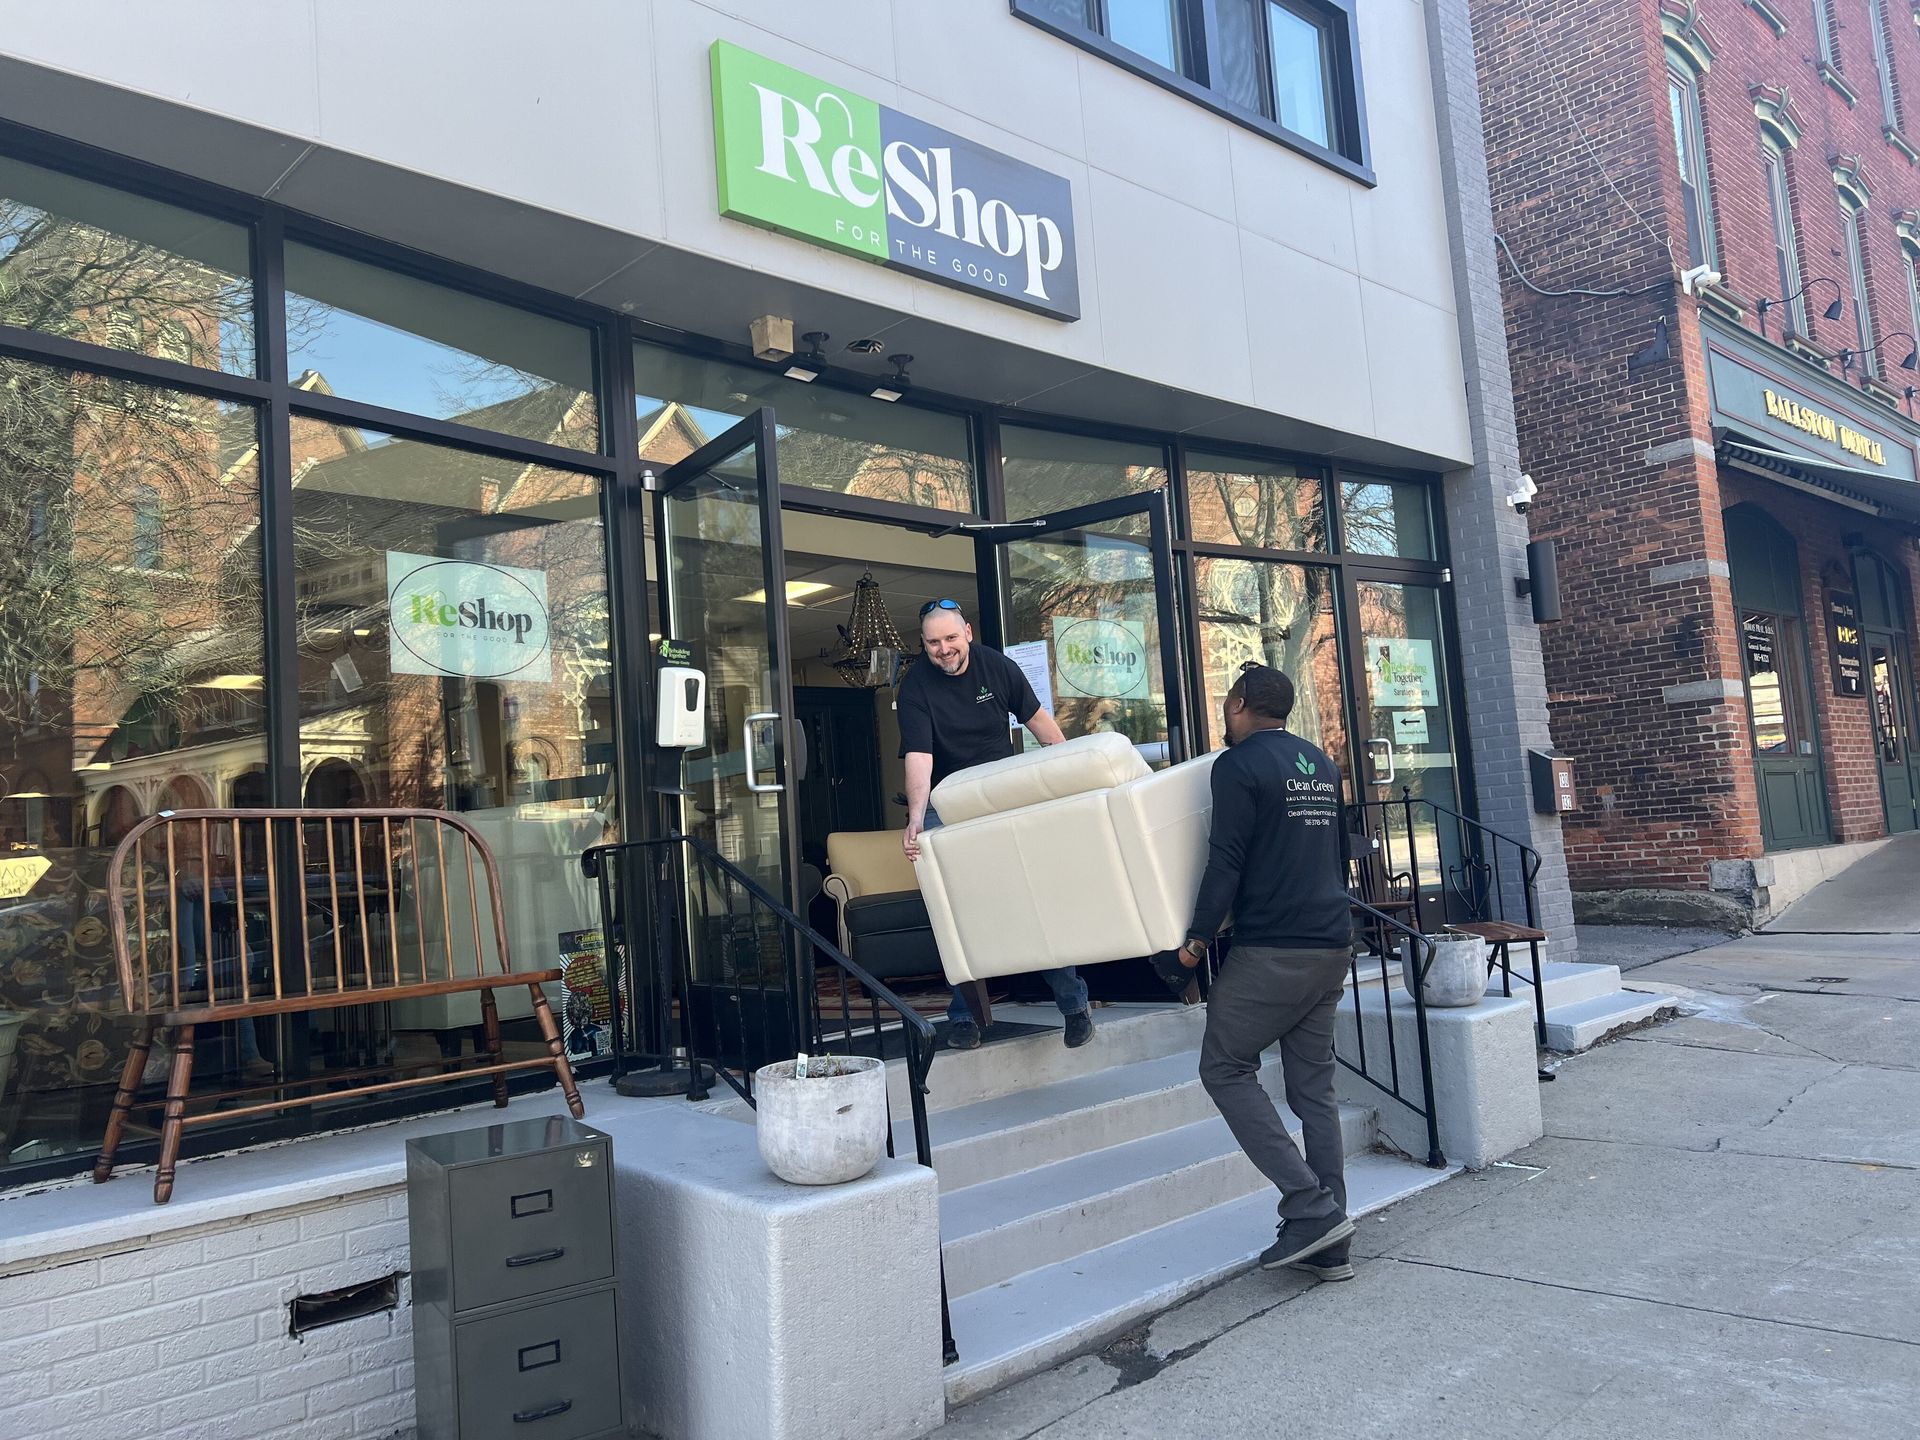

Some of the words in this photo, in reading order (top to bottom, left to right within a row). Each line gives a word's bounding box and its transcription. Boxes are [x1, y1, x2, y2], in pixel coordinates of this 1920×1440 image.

[749, 81, 1063, 301] ReShop
[835, 219, 881, 248] FOR
[896, 240, 937, 266] THE
[952, 259, 1009, 288] GOOD
[410, 594, 533, 645] ReShop
[461, 633, 478, 641] THE
[483, 635, 508, 643] GOOD
[1066, 642, 1137, 674] ReShop
[1286, 778, 1311, 792] Clean
[1311, 779, 1335, 793] Green
